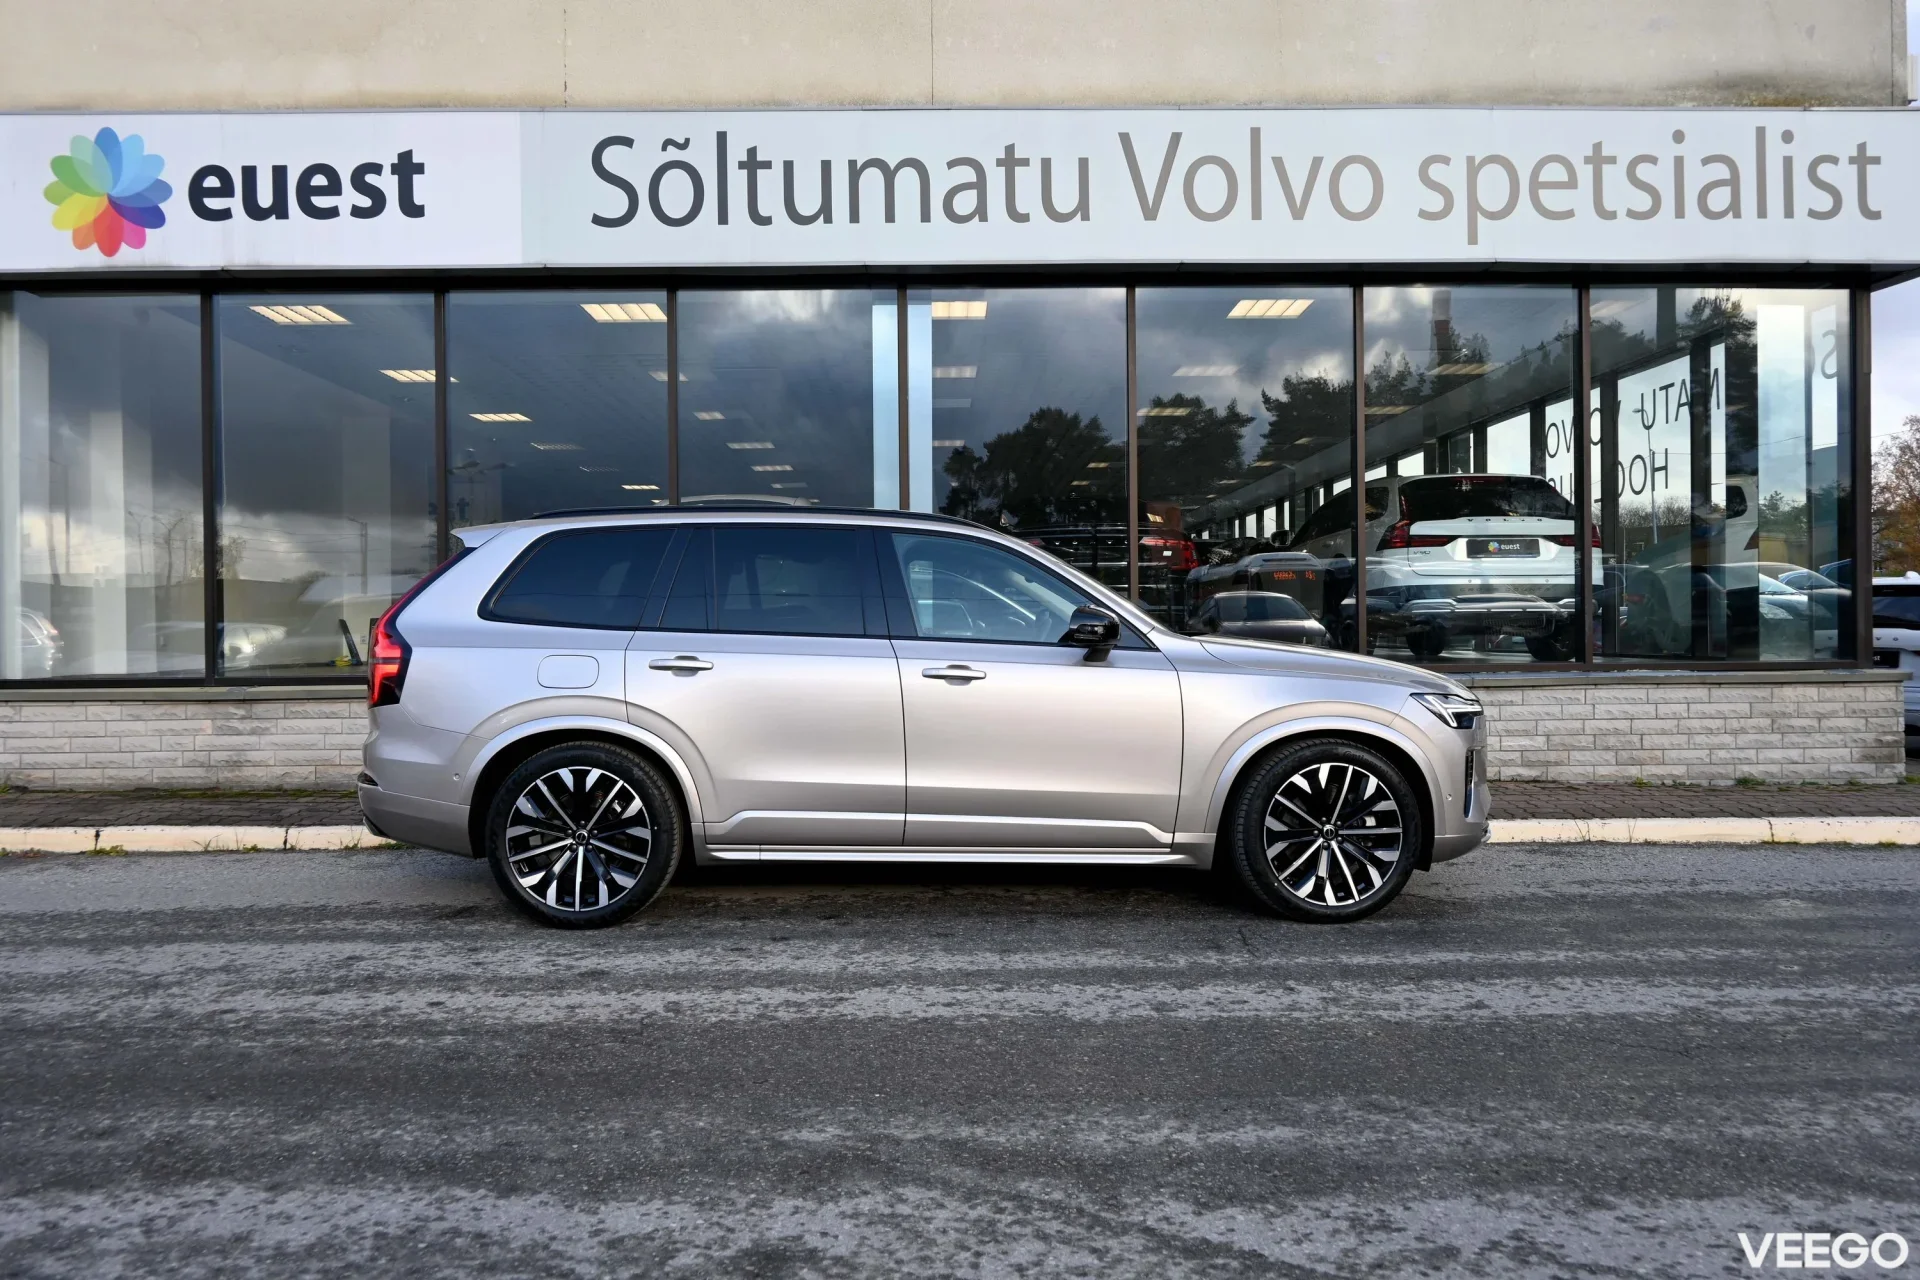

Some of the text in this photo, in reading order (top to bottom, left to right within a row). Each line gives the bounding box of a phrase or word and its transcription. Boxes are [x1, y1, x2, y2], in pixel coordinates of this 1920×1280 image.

[188, 148, 425, 222] euest
[590, 125, 1882, 245] Sõltumatu Volvo spetsialist
